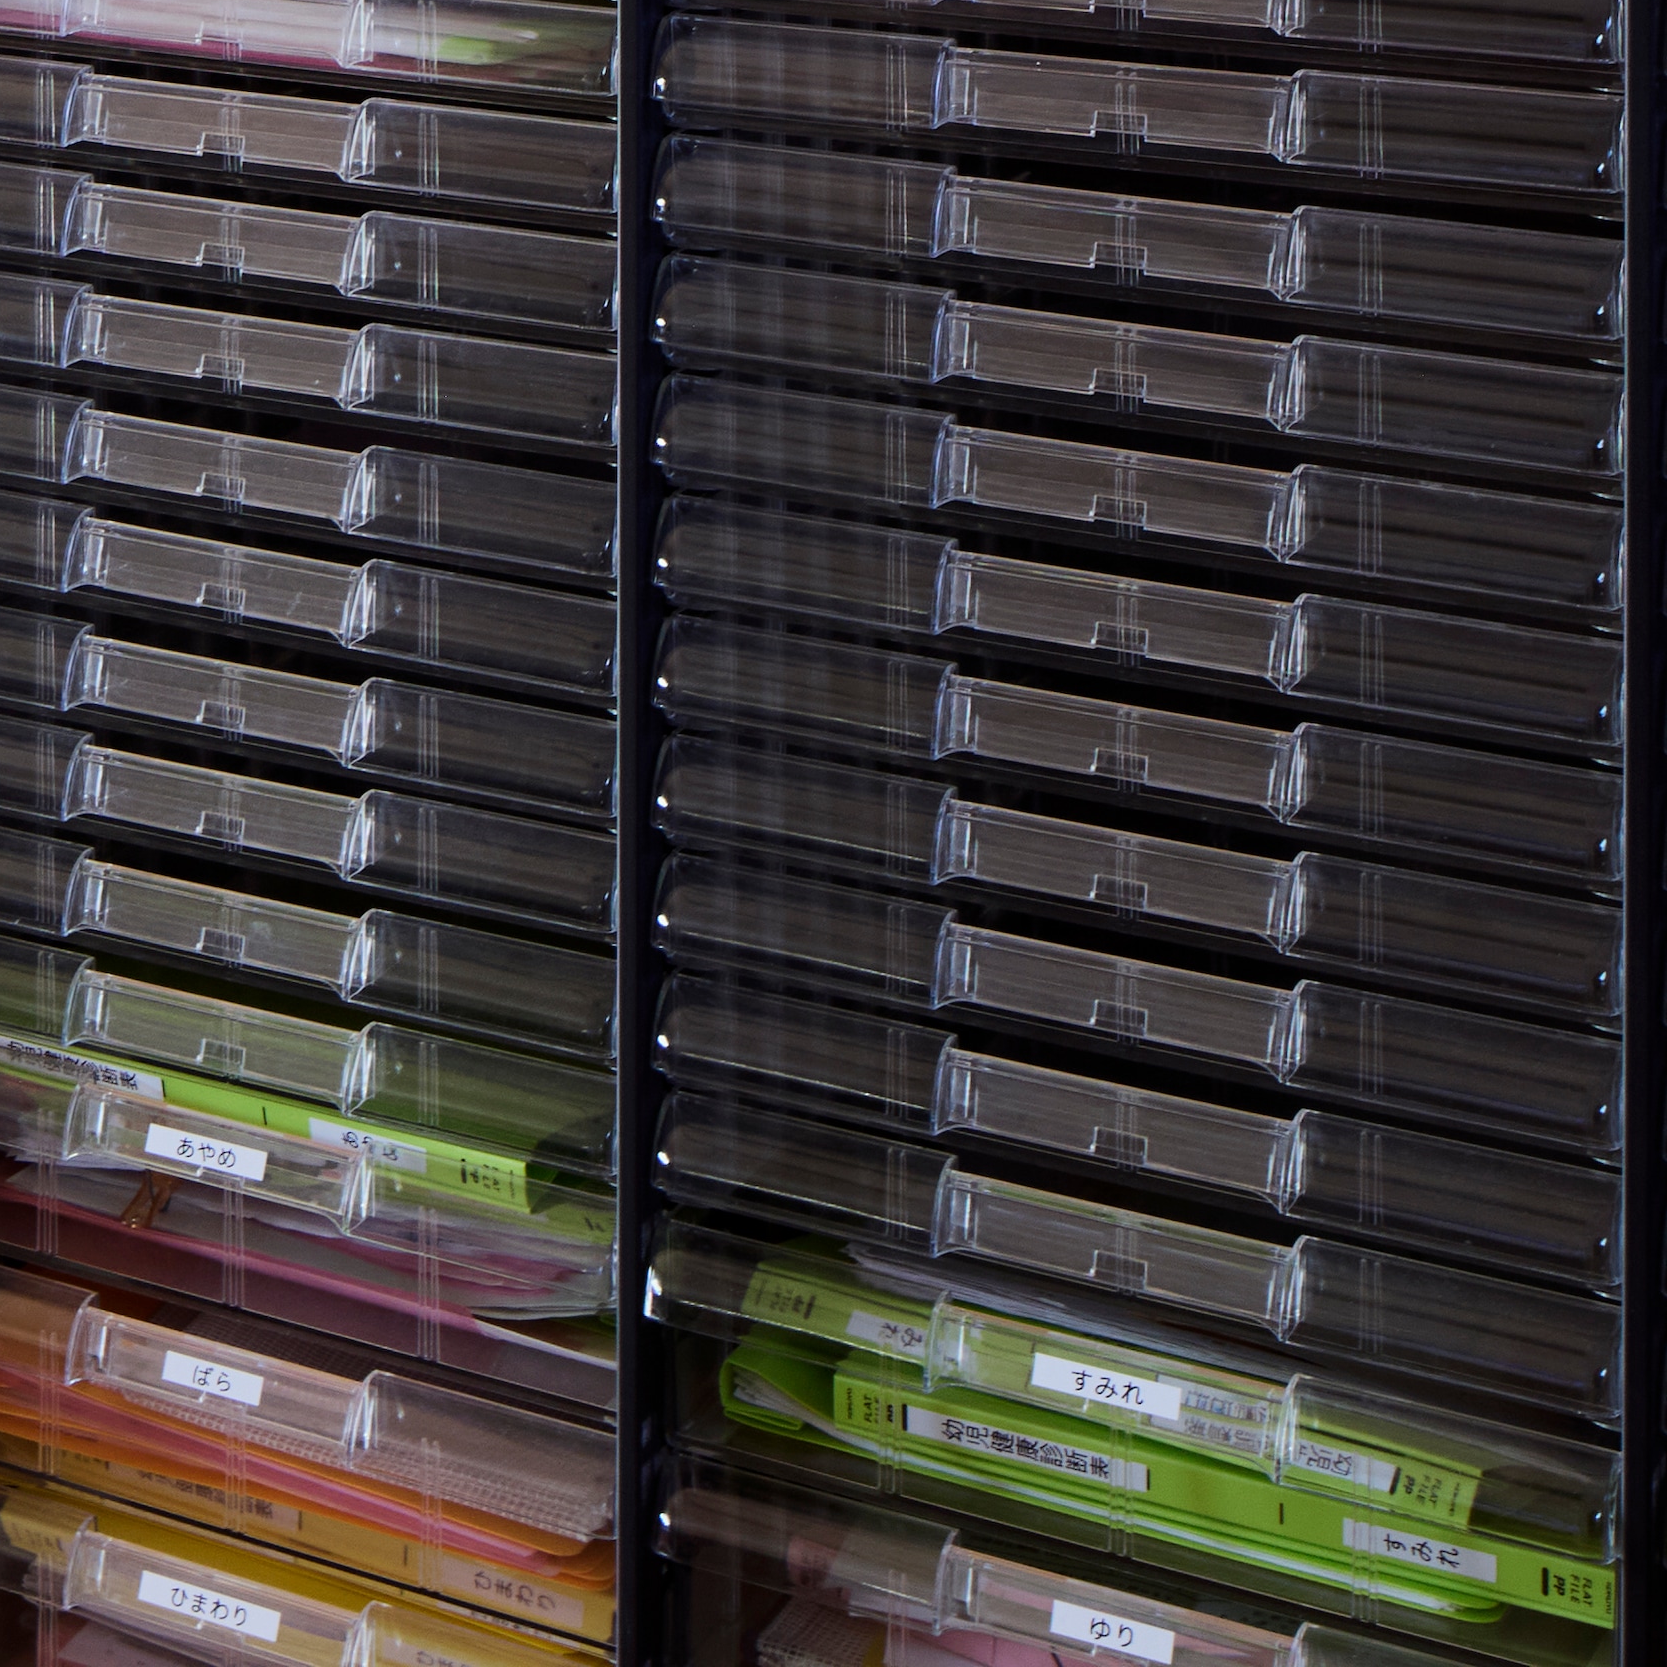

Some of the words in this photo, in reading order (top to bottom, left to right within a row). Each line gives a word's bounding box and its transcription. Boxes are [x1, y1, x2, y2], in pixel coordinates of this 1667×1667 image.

[177, 1137, 239, 1170] あやめ
[192, 1362, 233, 1393] ばら
[1070, 1369, 1145, 1405] すみれ
[864, 1395, 873, 1424] FLAT
[940, 1418, 1110, 1479] 幼児健康診断表
[1383, 1532, 1460, 1569] すみれ
[474, 1570, 557, 1610] ひまわり
[1555, 1574, 1566, 1596] PP
[1569, 1574, 1580, 1604] FILE
[1582, 1577, 1594, 1609] FLAT
[170, 1586, 248, 1627] ひまわり
[1088, 1613, 1136, 1649] ゆり
